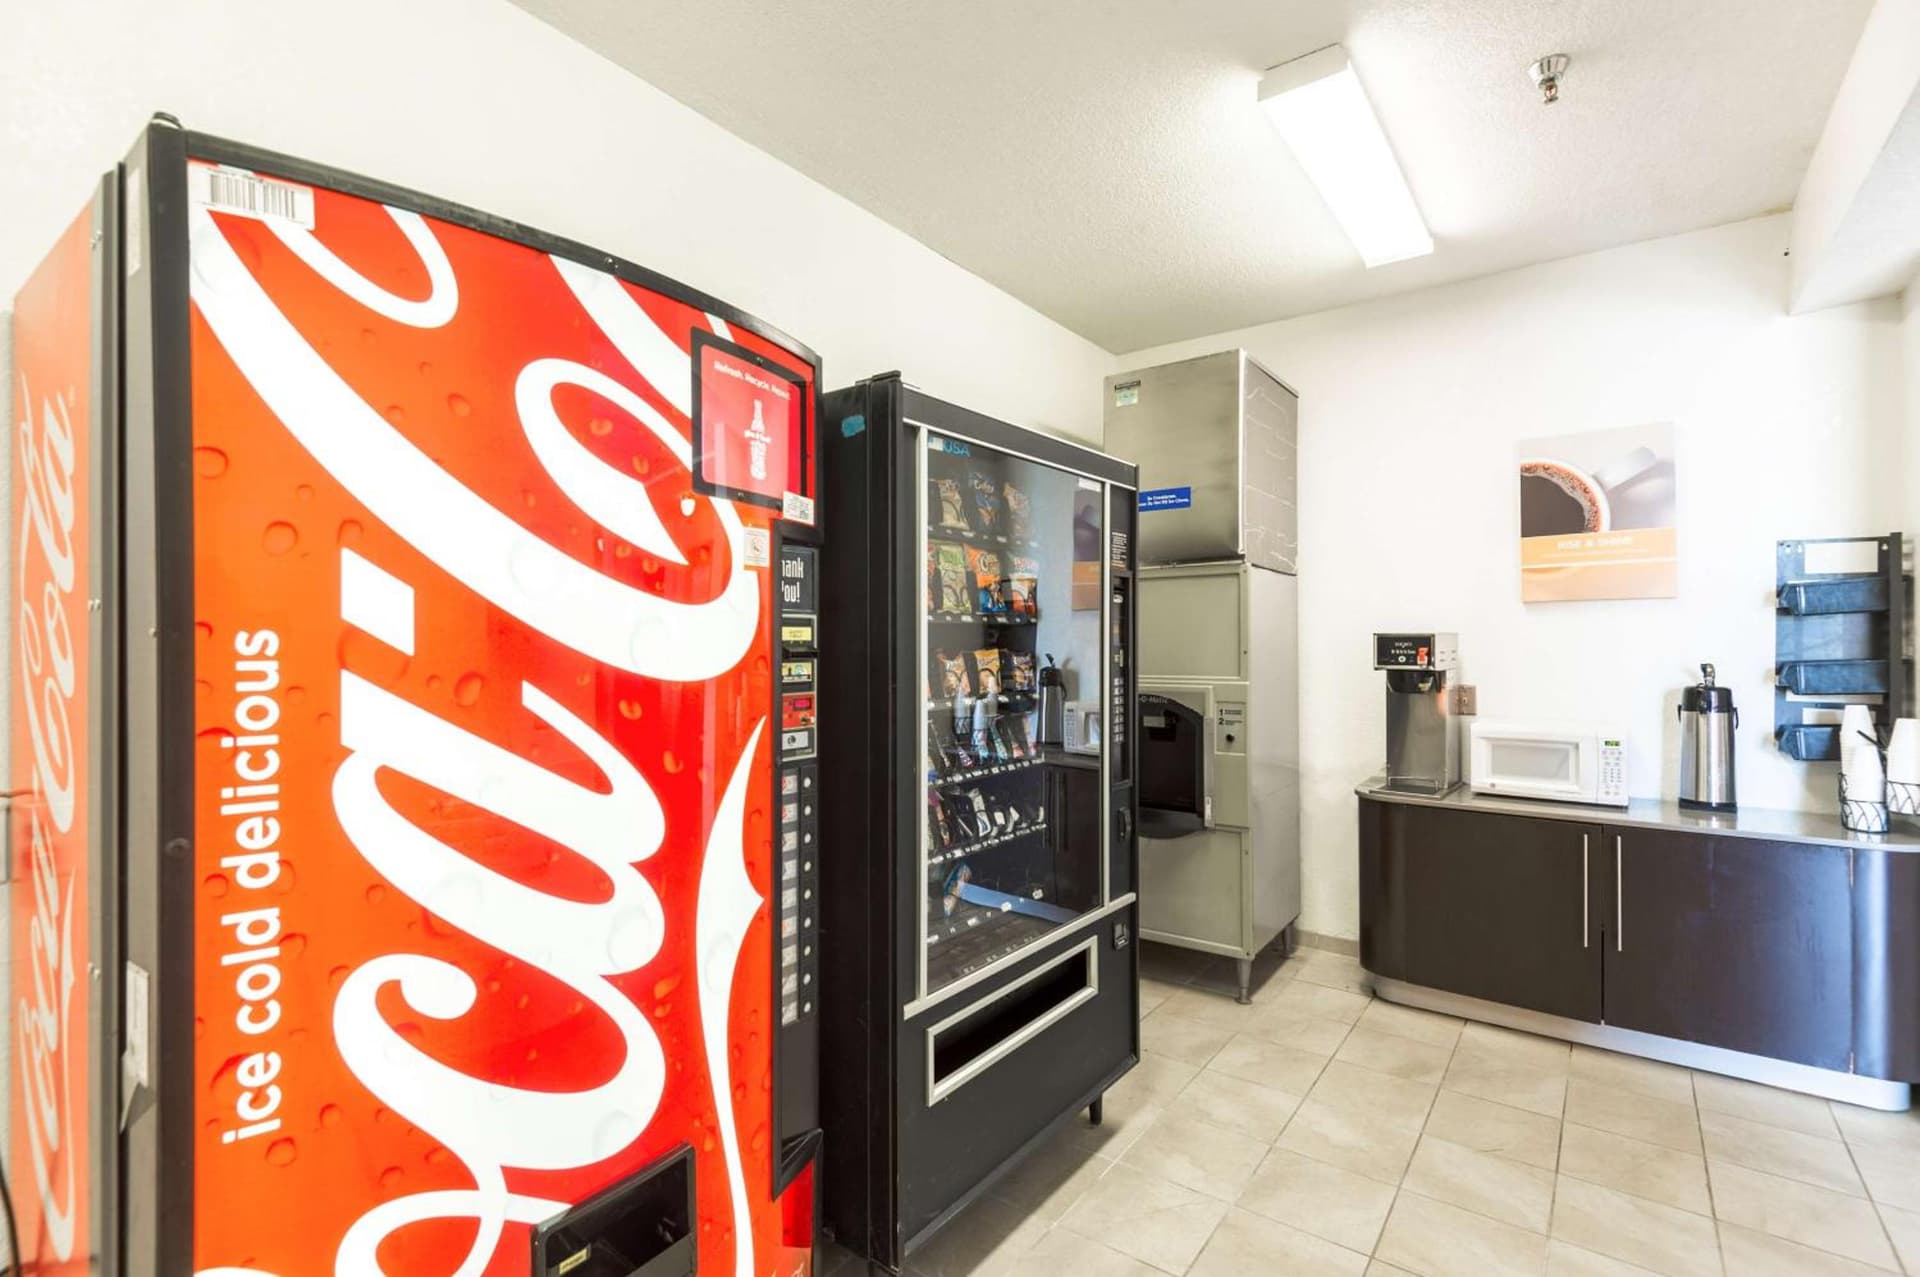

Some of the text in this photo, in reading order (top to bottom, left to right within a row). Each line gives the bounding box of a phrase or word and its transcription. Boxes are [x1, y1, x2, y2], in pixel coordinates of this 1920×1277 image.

[943, 439, 971, 457] USA
[17, 369, 76, 1263] Coca-Cola
[1218, 717, 1225, 726] 2
[219, 627, 283, 1146] ice cold delicious
